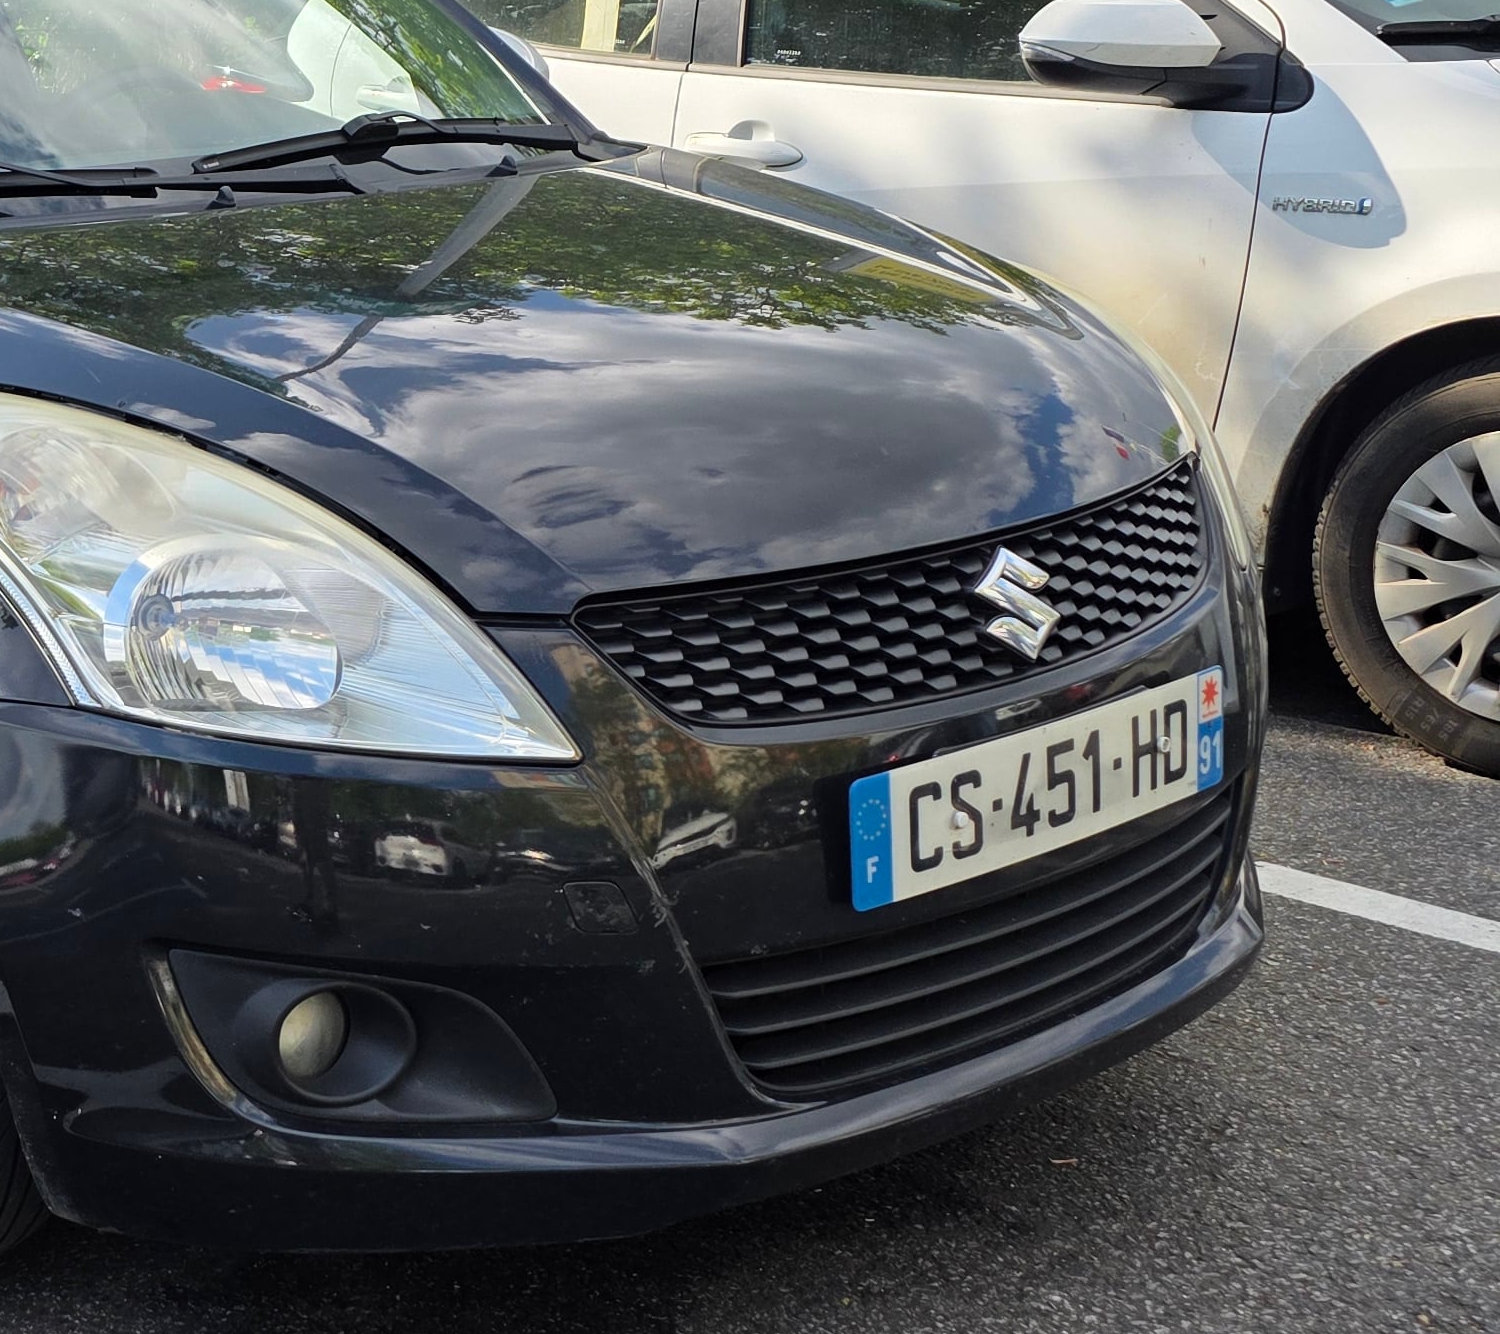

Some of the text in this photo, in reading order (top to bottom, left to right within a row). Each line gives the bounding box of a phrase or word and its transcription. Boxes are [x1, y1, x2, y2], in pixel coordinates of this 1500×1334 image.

[1272, 197, 1357, 214] HYBRID
[1200, 730, 1221, 774] 91
[909, 699, 1188, 874] CS-451-HD
[867, 855, 879, 884] F
